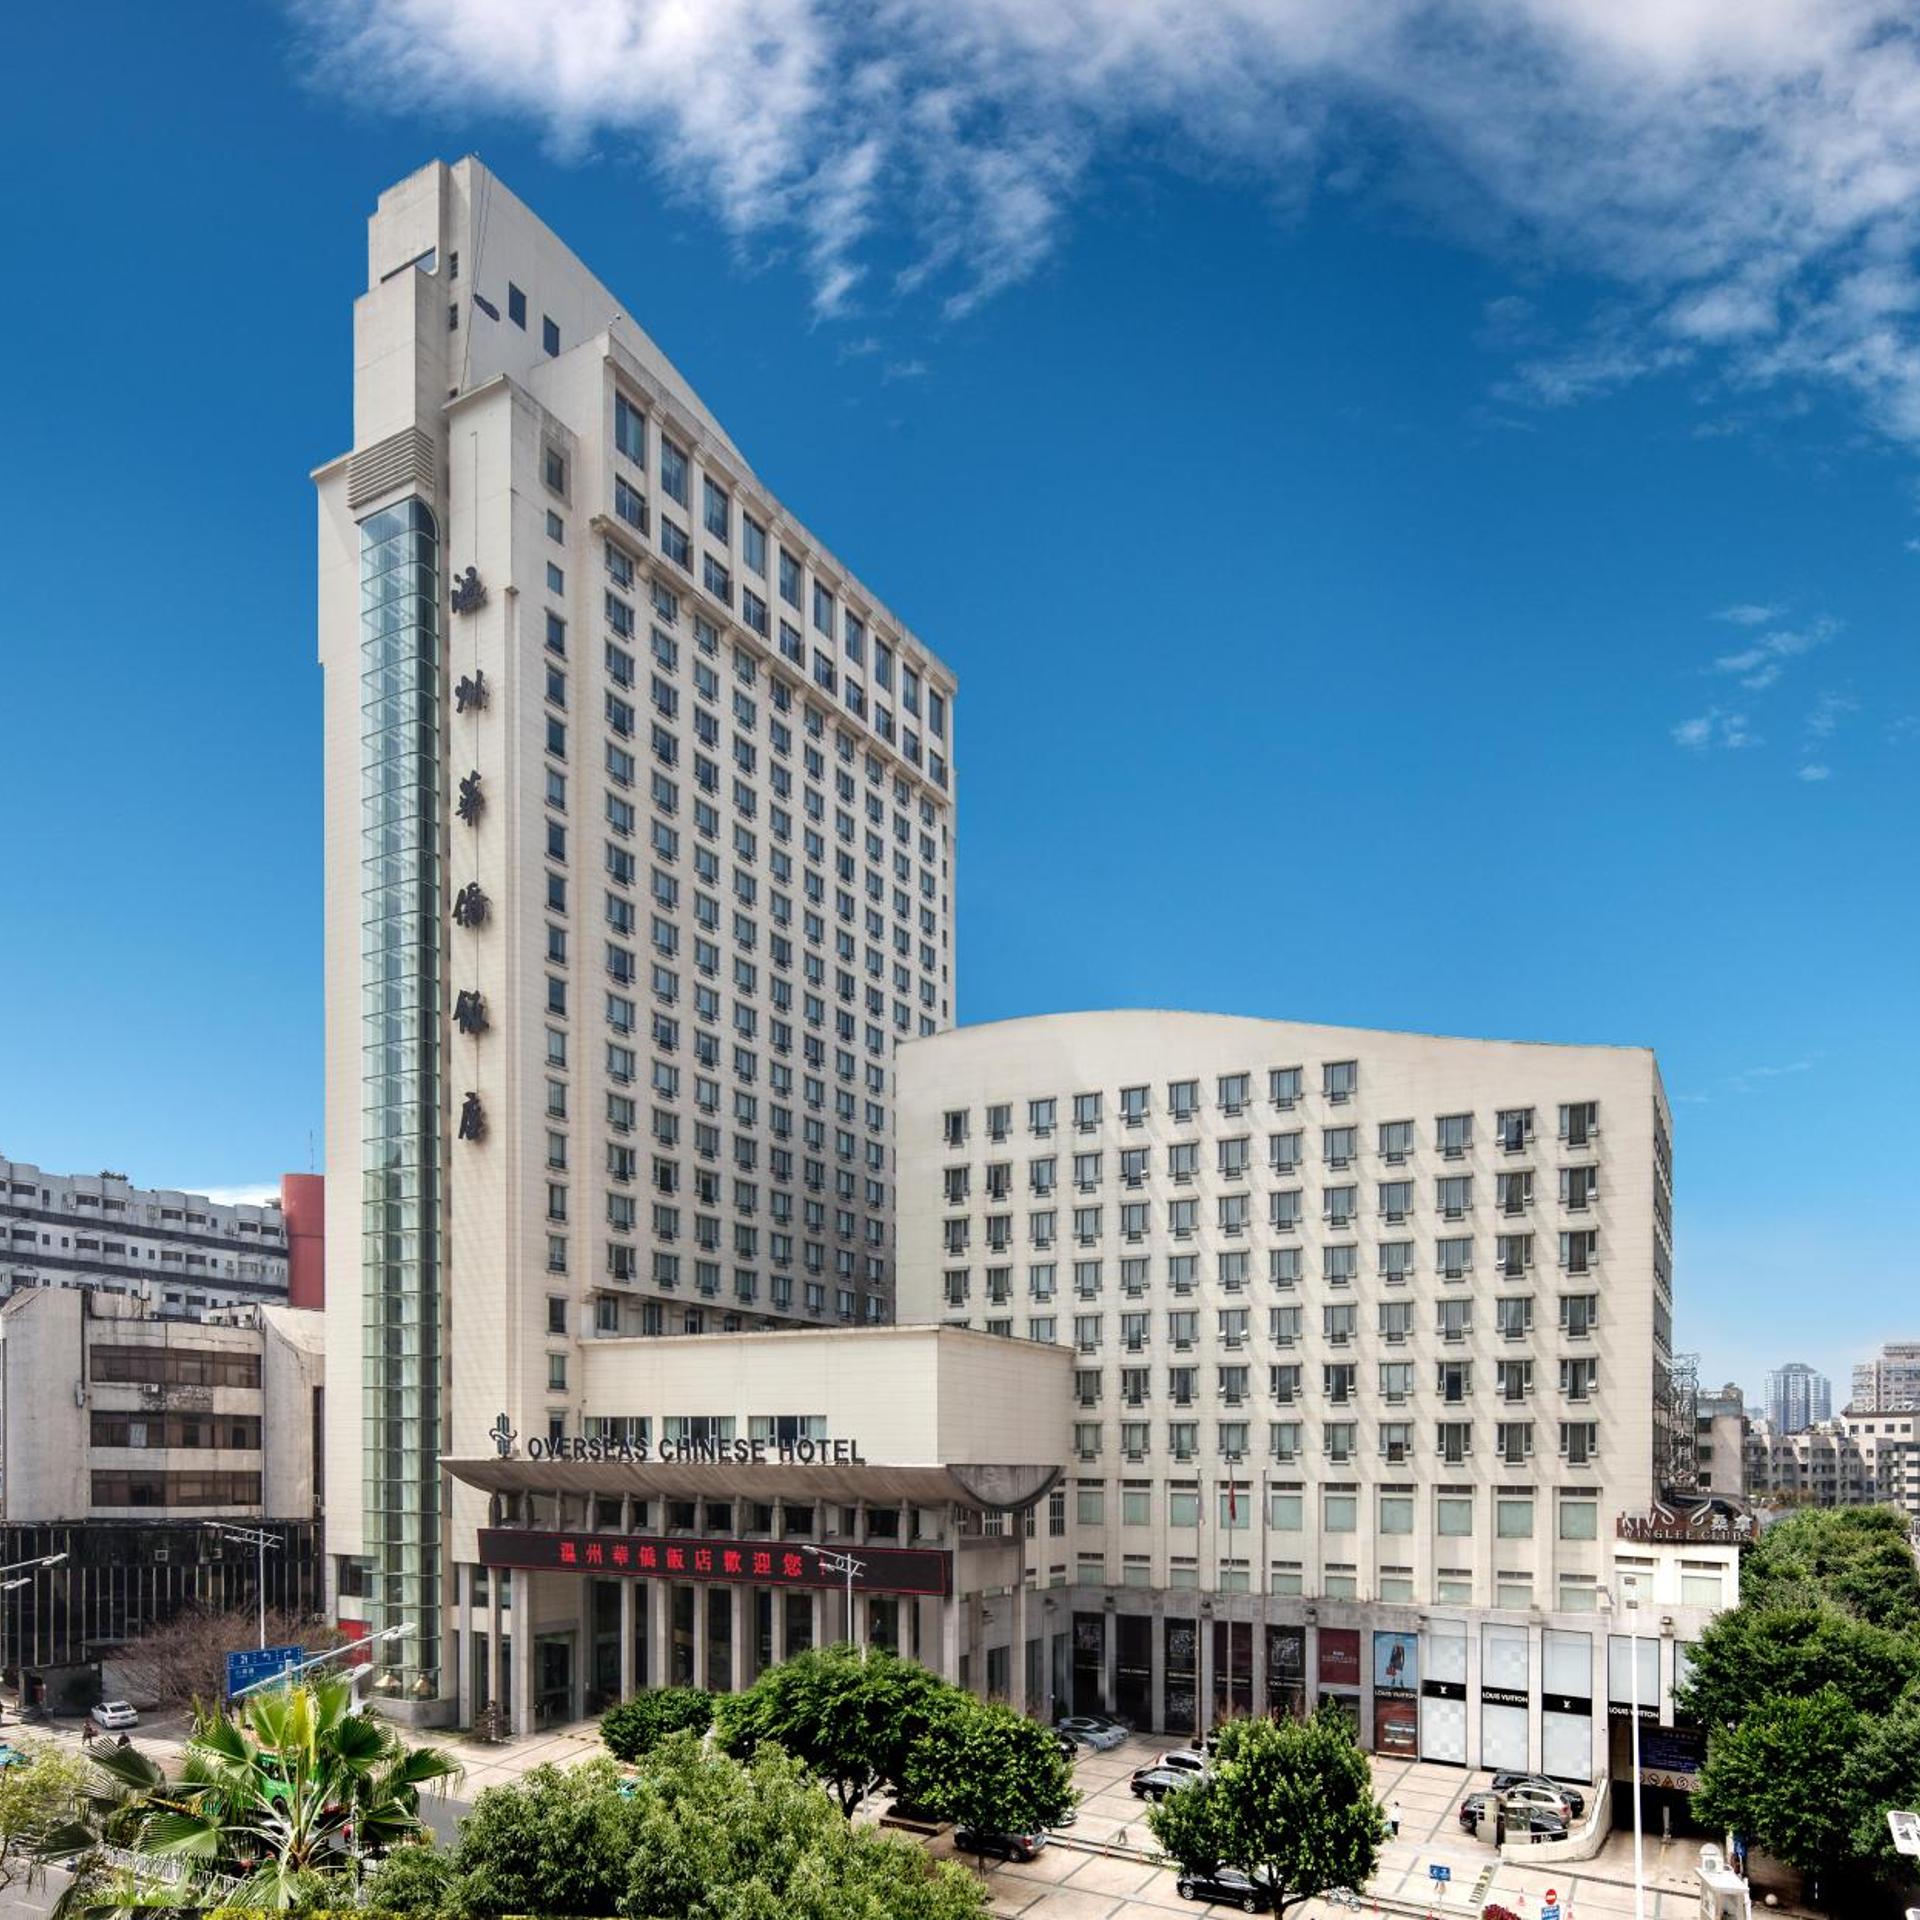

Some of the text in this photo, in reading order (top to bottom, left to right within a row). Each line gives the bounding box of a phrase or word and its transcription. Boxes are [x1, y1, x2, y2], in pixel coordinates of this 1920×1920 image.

[527, 1437, 866, 1464] OVERSEAS CHINESE HOTEL
[1482, 1691, 1529, 1703] LOUIS VUTTON
[1609, 1706, 1659, 1719] LOUIS VTTON
